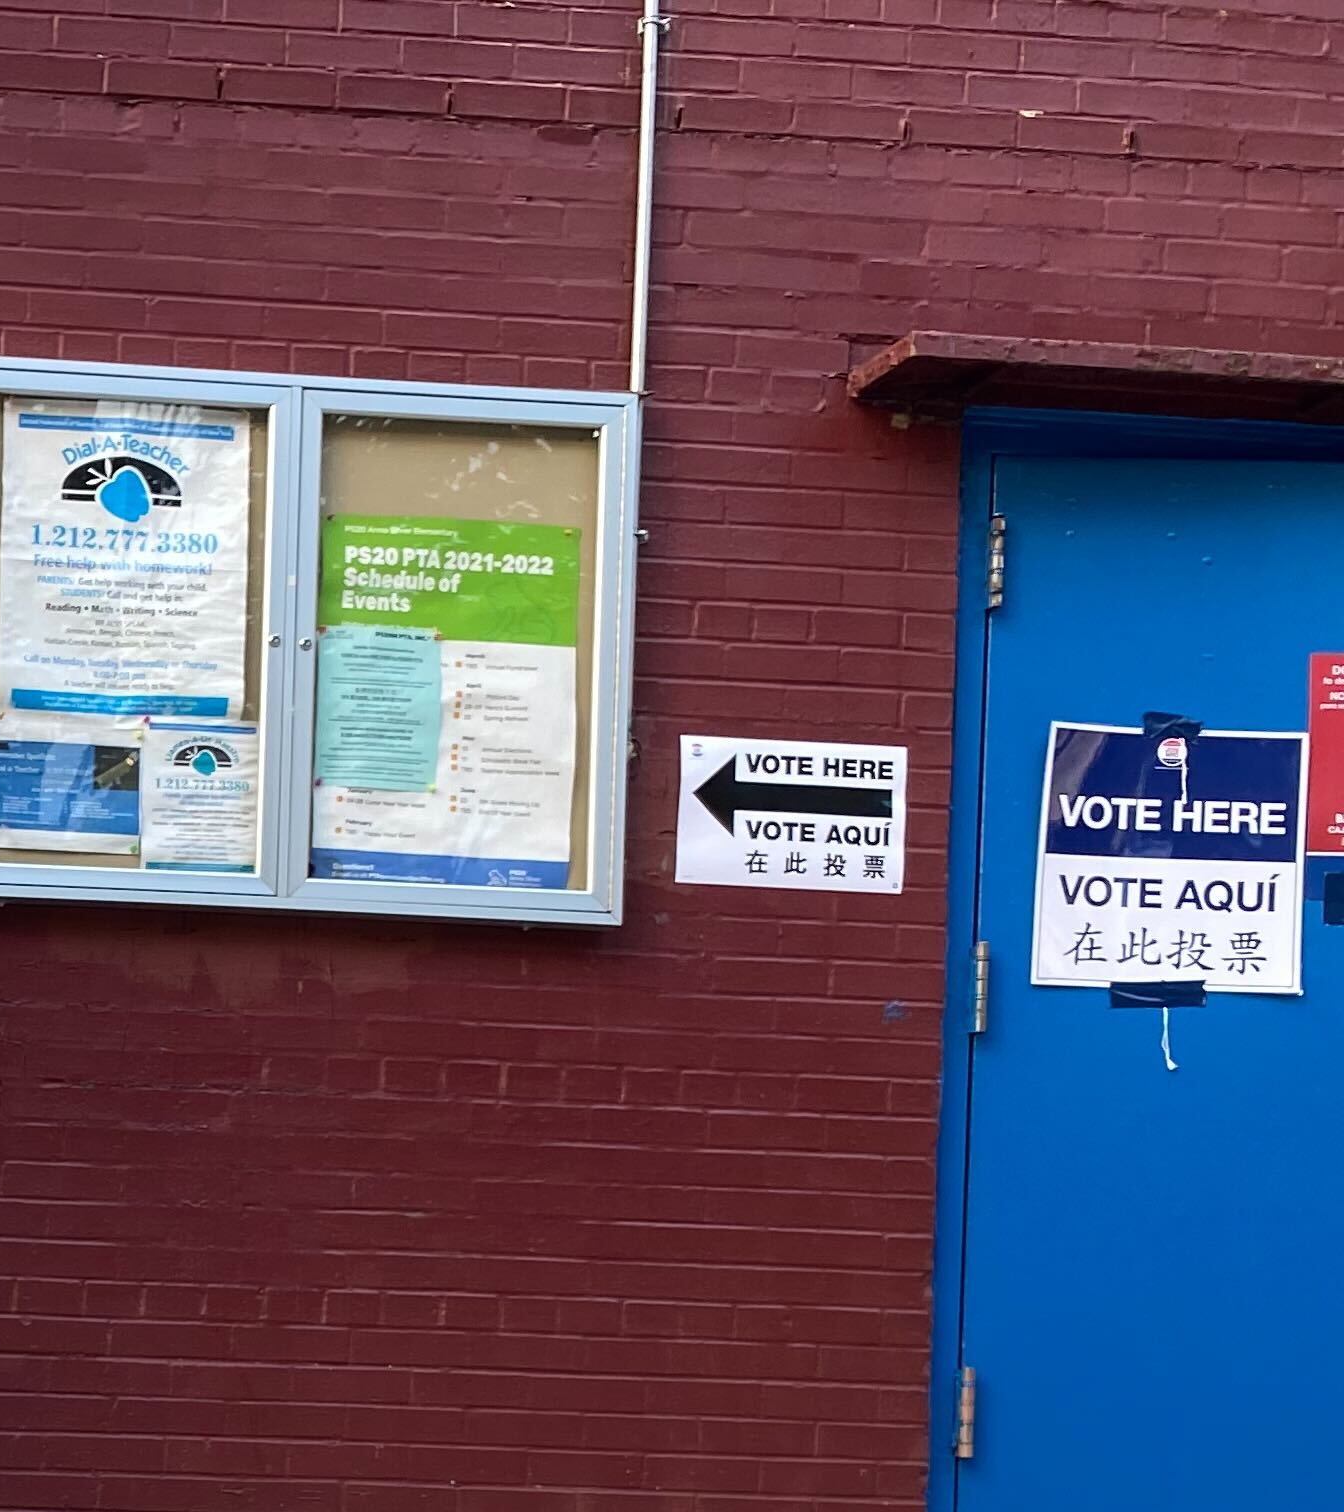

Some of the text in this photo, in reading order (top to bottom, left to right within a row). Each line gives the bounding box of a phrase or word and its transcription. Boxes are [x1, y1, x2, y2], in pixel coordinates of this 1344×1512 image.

[31, 523, 219, 555] 1.212.777.3380
[33, 554, 213, 577] Free help with homework!
[344, 545, 554, 576] PS20 PTA 2021-2022
[343, 566, 462, 593] Schedule of
[45, 602, 82, 615] Reading
[165, 607, 198, 618] Science
[341, 589, 411, 613] Events
[745, 753, 895, 780] VOTE HERE
[1058, 793, 1287, 836] VOTE HERE
[745, 819, 892, 847] VOTE AQUÍ
[744, 850, 886, 879] 在此投票
[1058, 873, 1280, 913] VOTE AQUÍ
[1063, 922, 1268, 975] 在此投票
